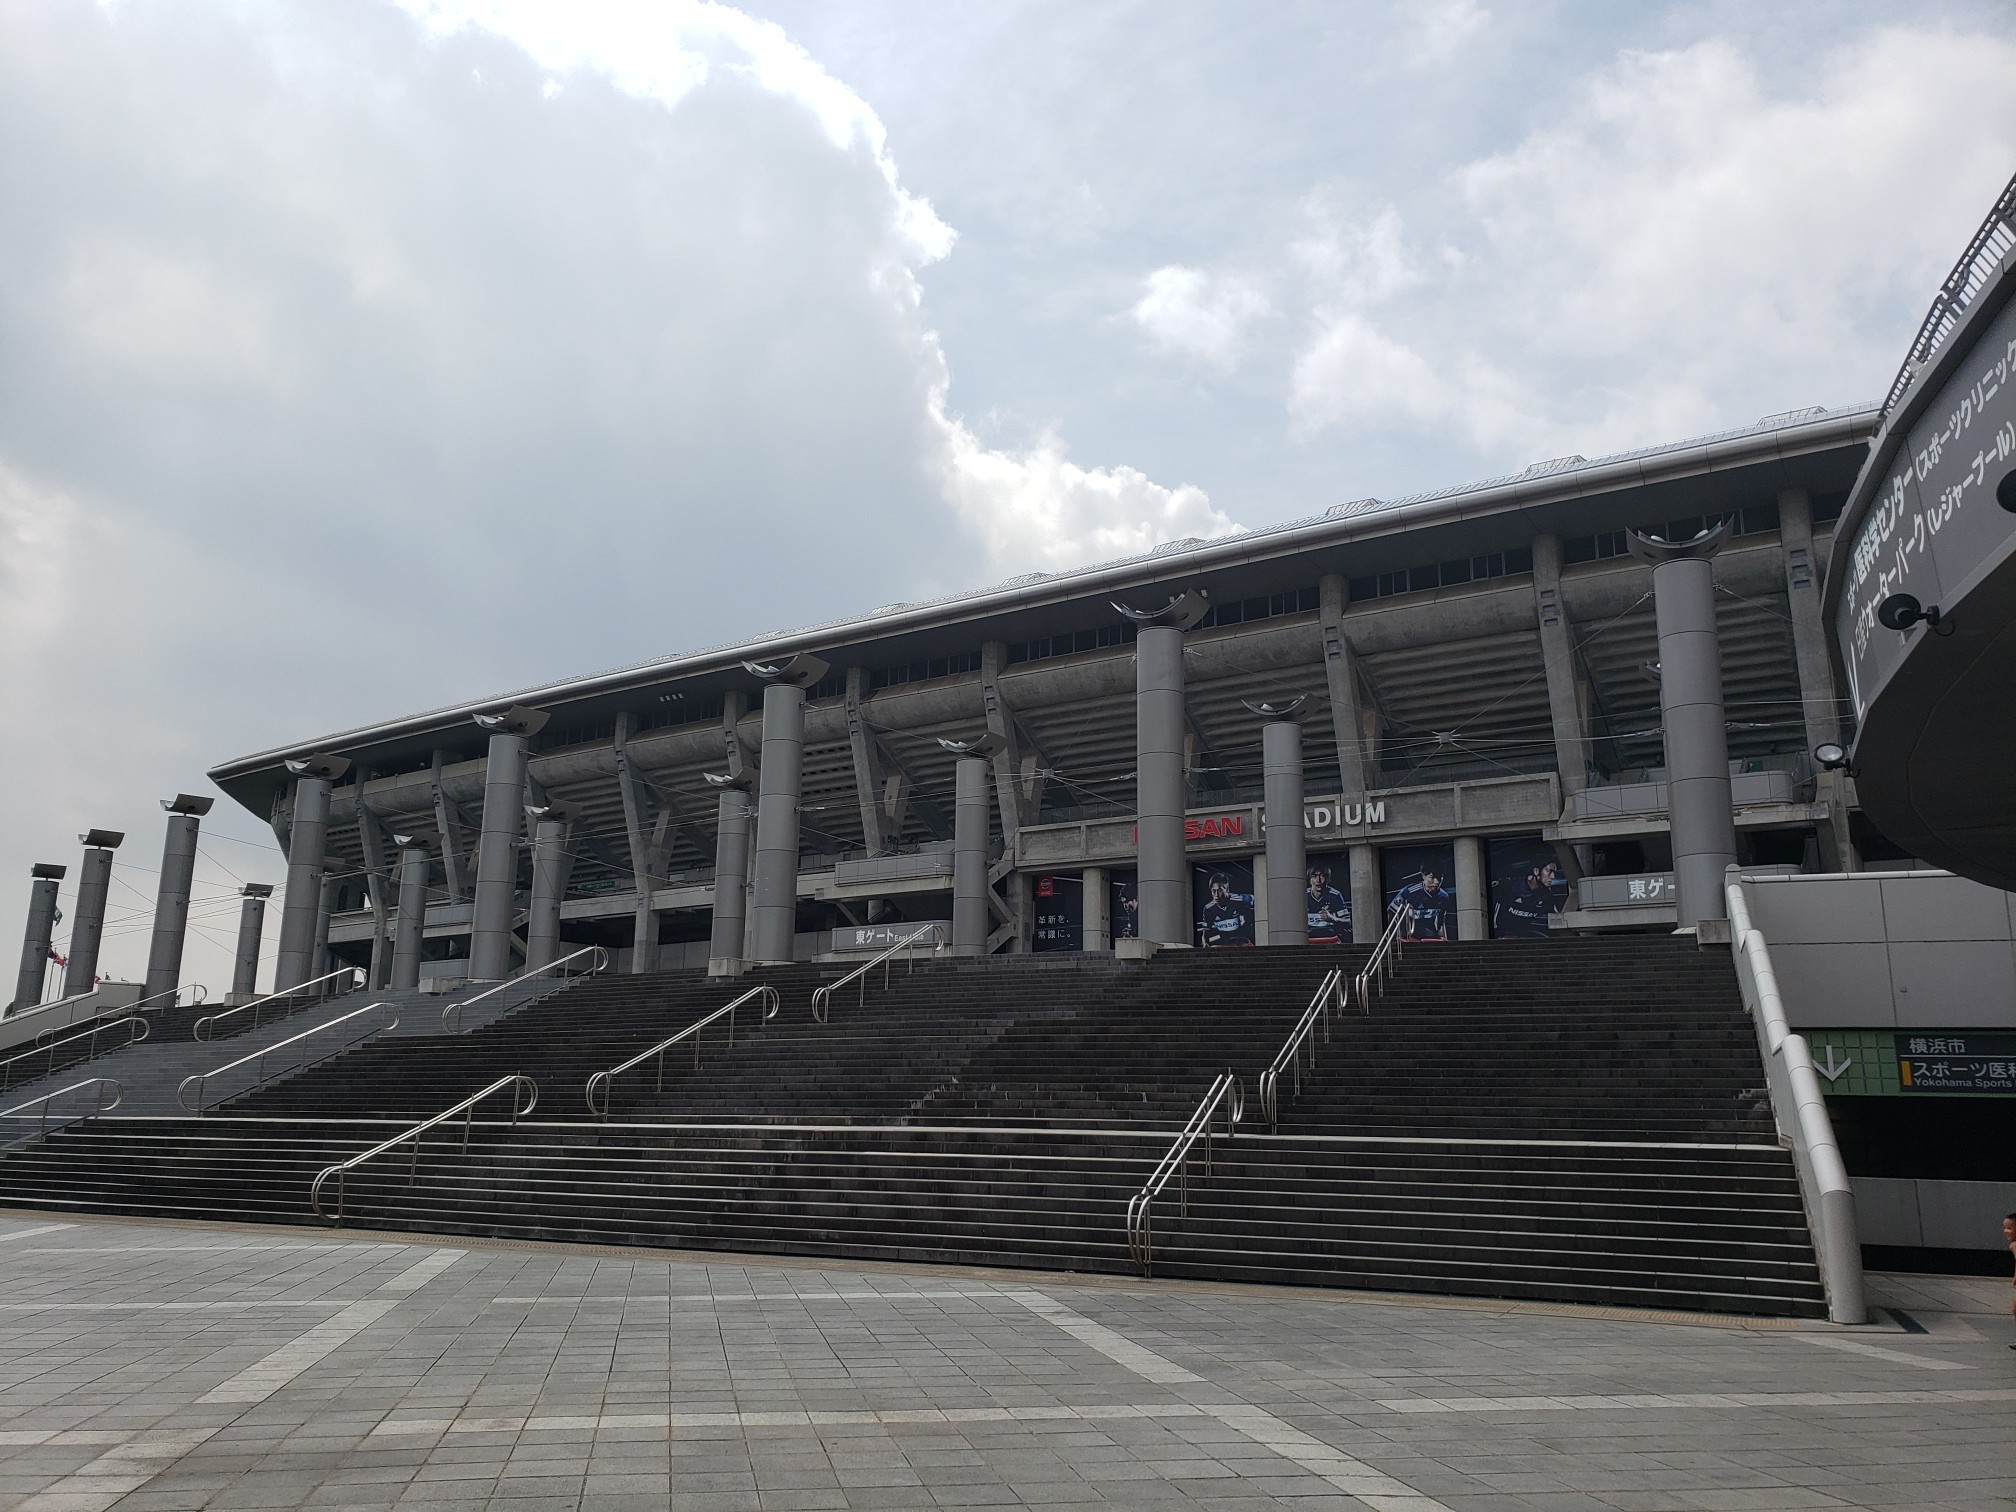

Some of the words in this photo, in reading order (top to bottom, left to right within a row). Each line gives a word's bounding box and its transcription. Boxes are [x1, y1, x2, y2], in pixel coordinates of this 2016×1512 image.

[1133, 816, 1242, 844] SAN
[1261, 801, 1386, 832] DIUM
[855, 928, 894, 944] 東ゲート
[1909, 1037, 1966, 1054] 横浜市
[1914, 1077, 1973, 1087] Yokohama
[1975, 1078, 2012, 1088] Sports
